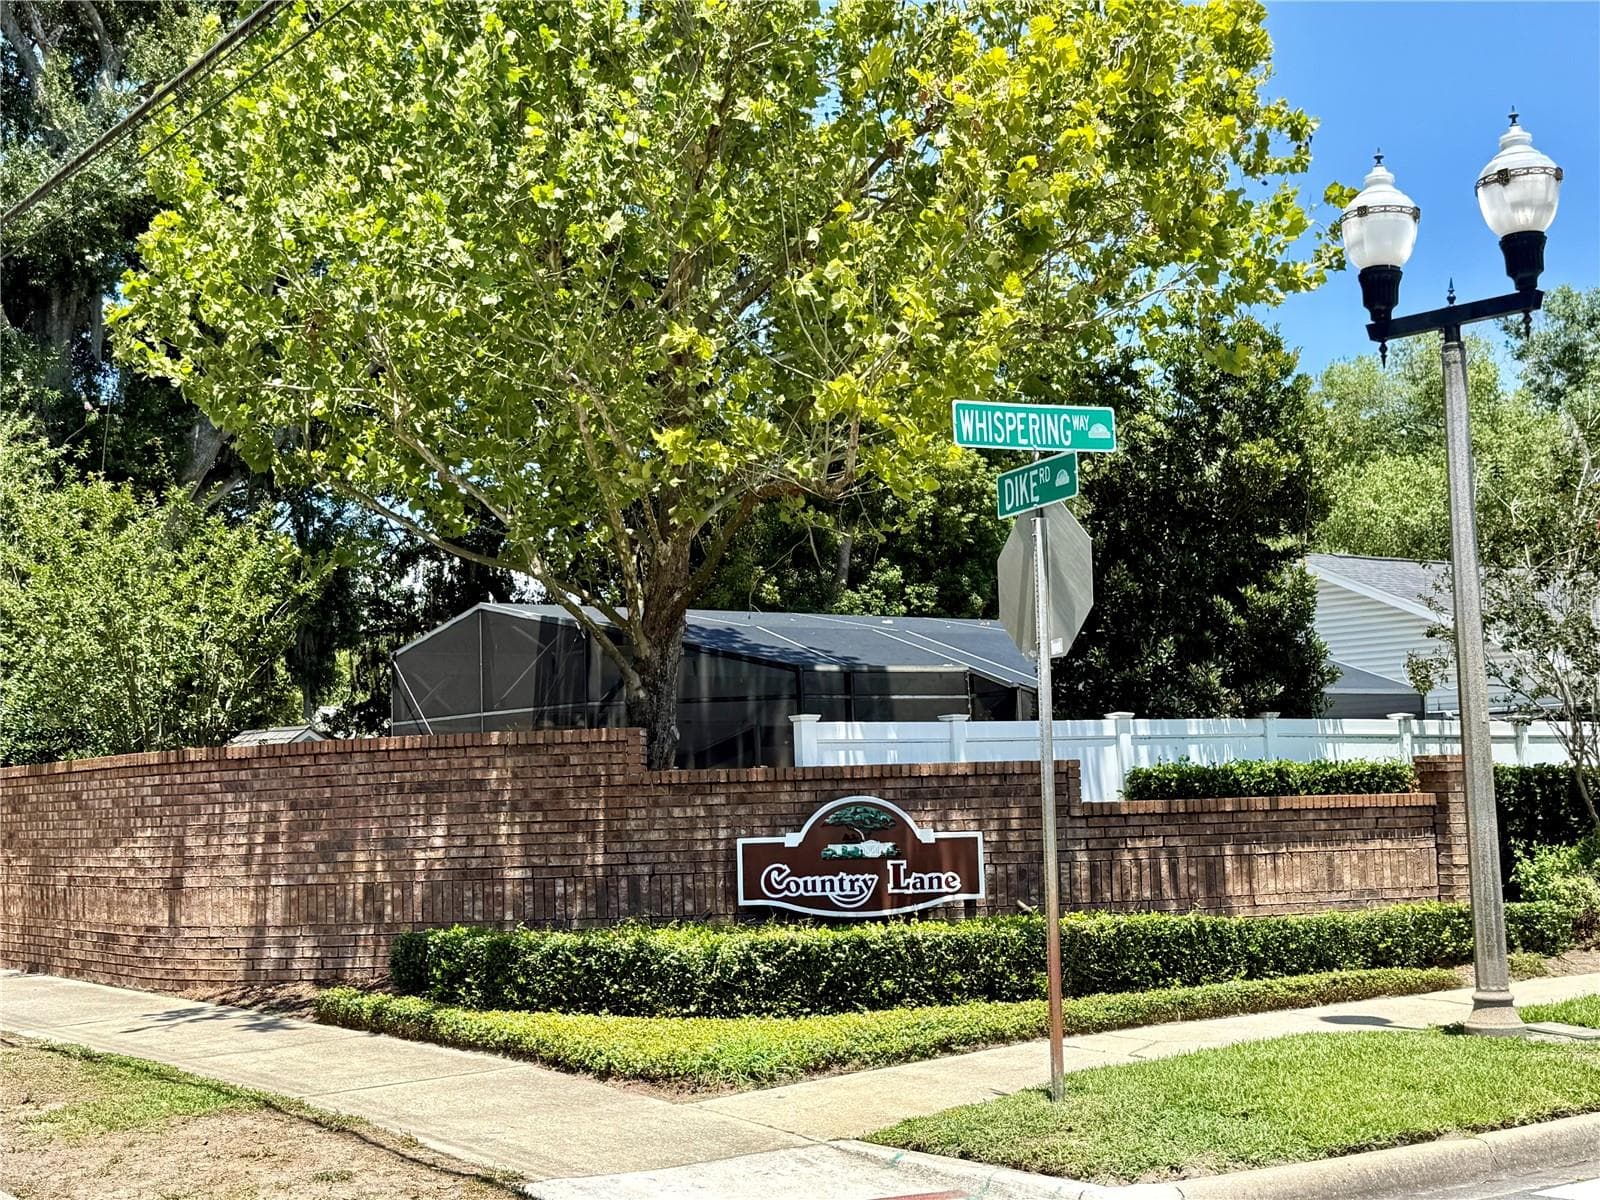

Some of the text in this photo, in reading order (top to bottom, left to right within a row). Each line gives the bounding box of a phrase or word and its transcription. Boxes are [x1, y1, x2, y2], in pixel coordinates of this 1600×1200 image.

[960, 409, 1089, 446] WHISPERING WAY
[1005, 466, 1051, 510] DIKE RD
[761, 860, 961, 908] Country Lane
